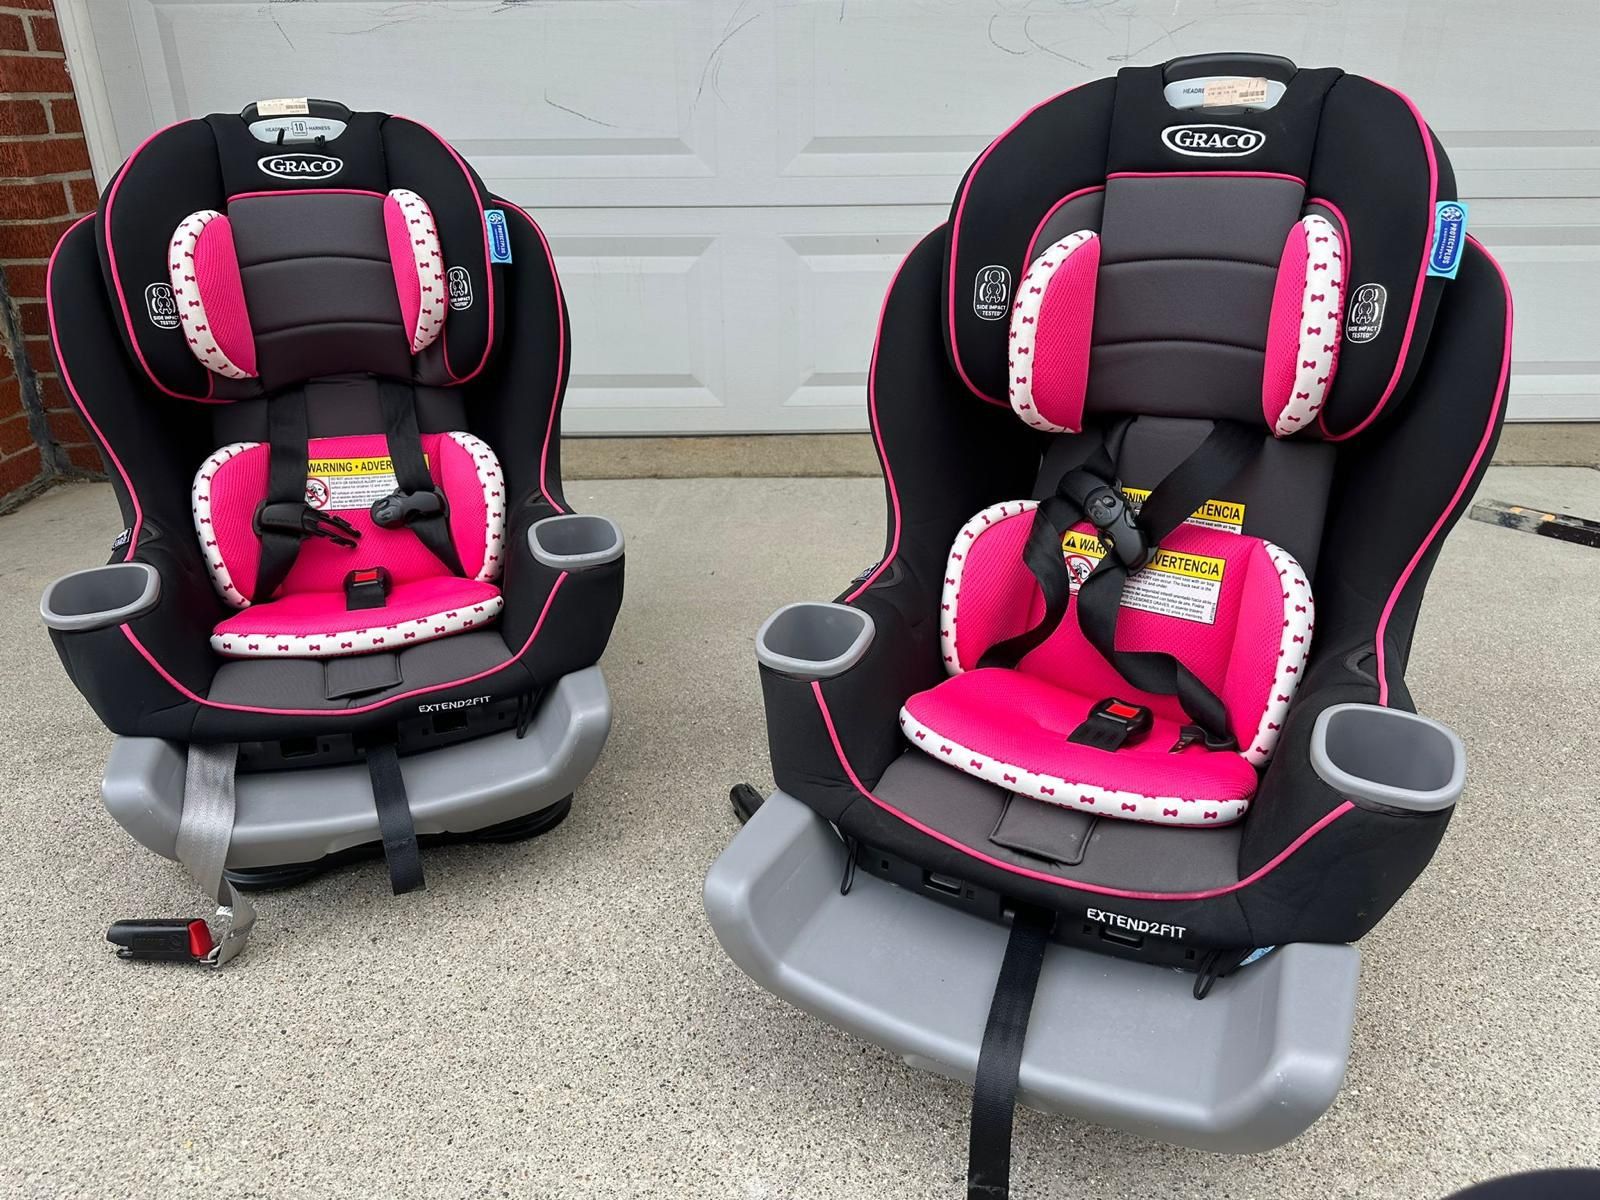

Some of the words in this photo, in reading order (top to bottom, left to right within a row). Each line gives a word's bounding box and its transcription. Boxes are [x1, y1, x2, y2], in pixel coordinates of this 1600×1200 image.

[294, 122, 304, 132] 10
[1174, 130, 1256, 149] GRACO
[270, 159, 336, 172] GRACO
[1442, 222, 1458, 264] PROTECTPLUS
[308, 462, 352, 473] WARNING
[360, 460, 392, 471] ADVER
[1194, 503, 1240, 520] TENCIA
[1080, 538, 1106, 555] WAR
[1154, 555, 1220, 576] VERTENCIA
[418, 696, 492, 712] EXTEND2FIT
[1086, 908, 1186, 938] EXTEND2FIT
